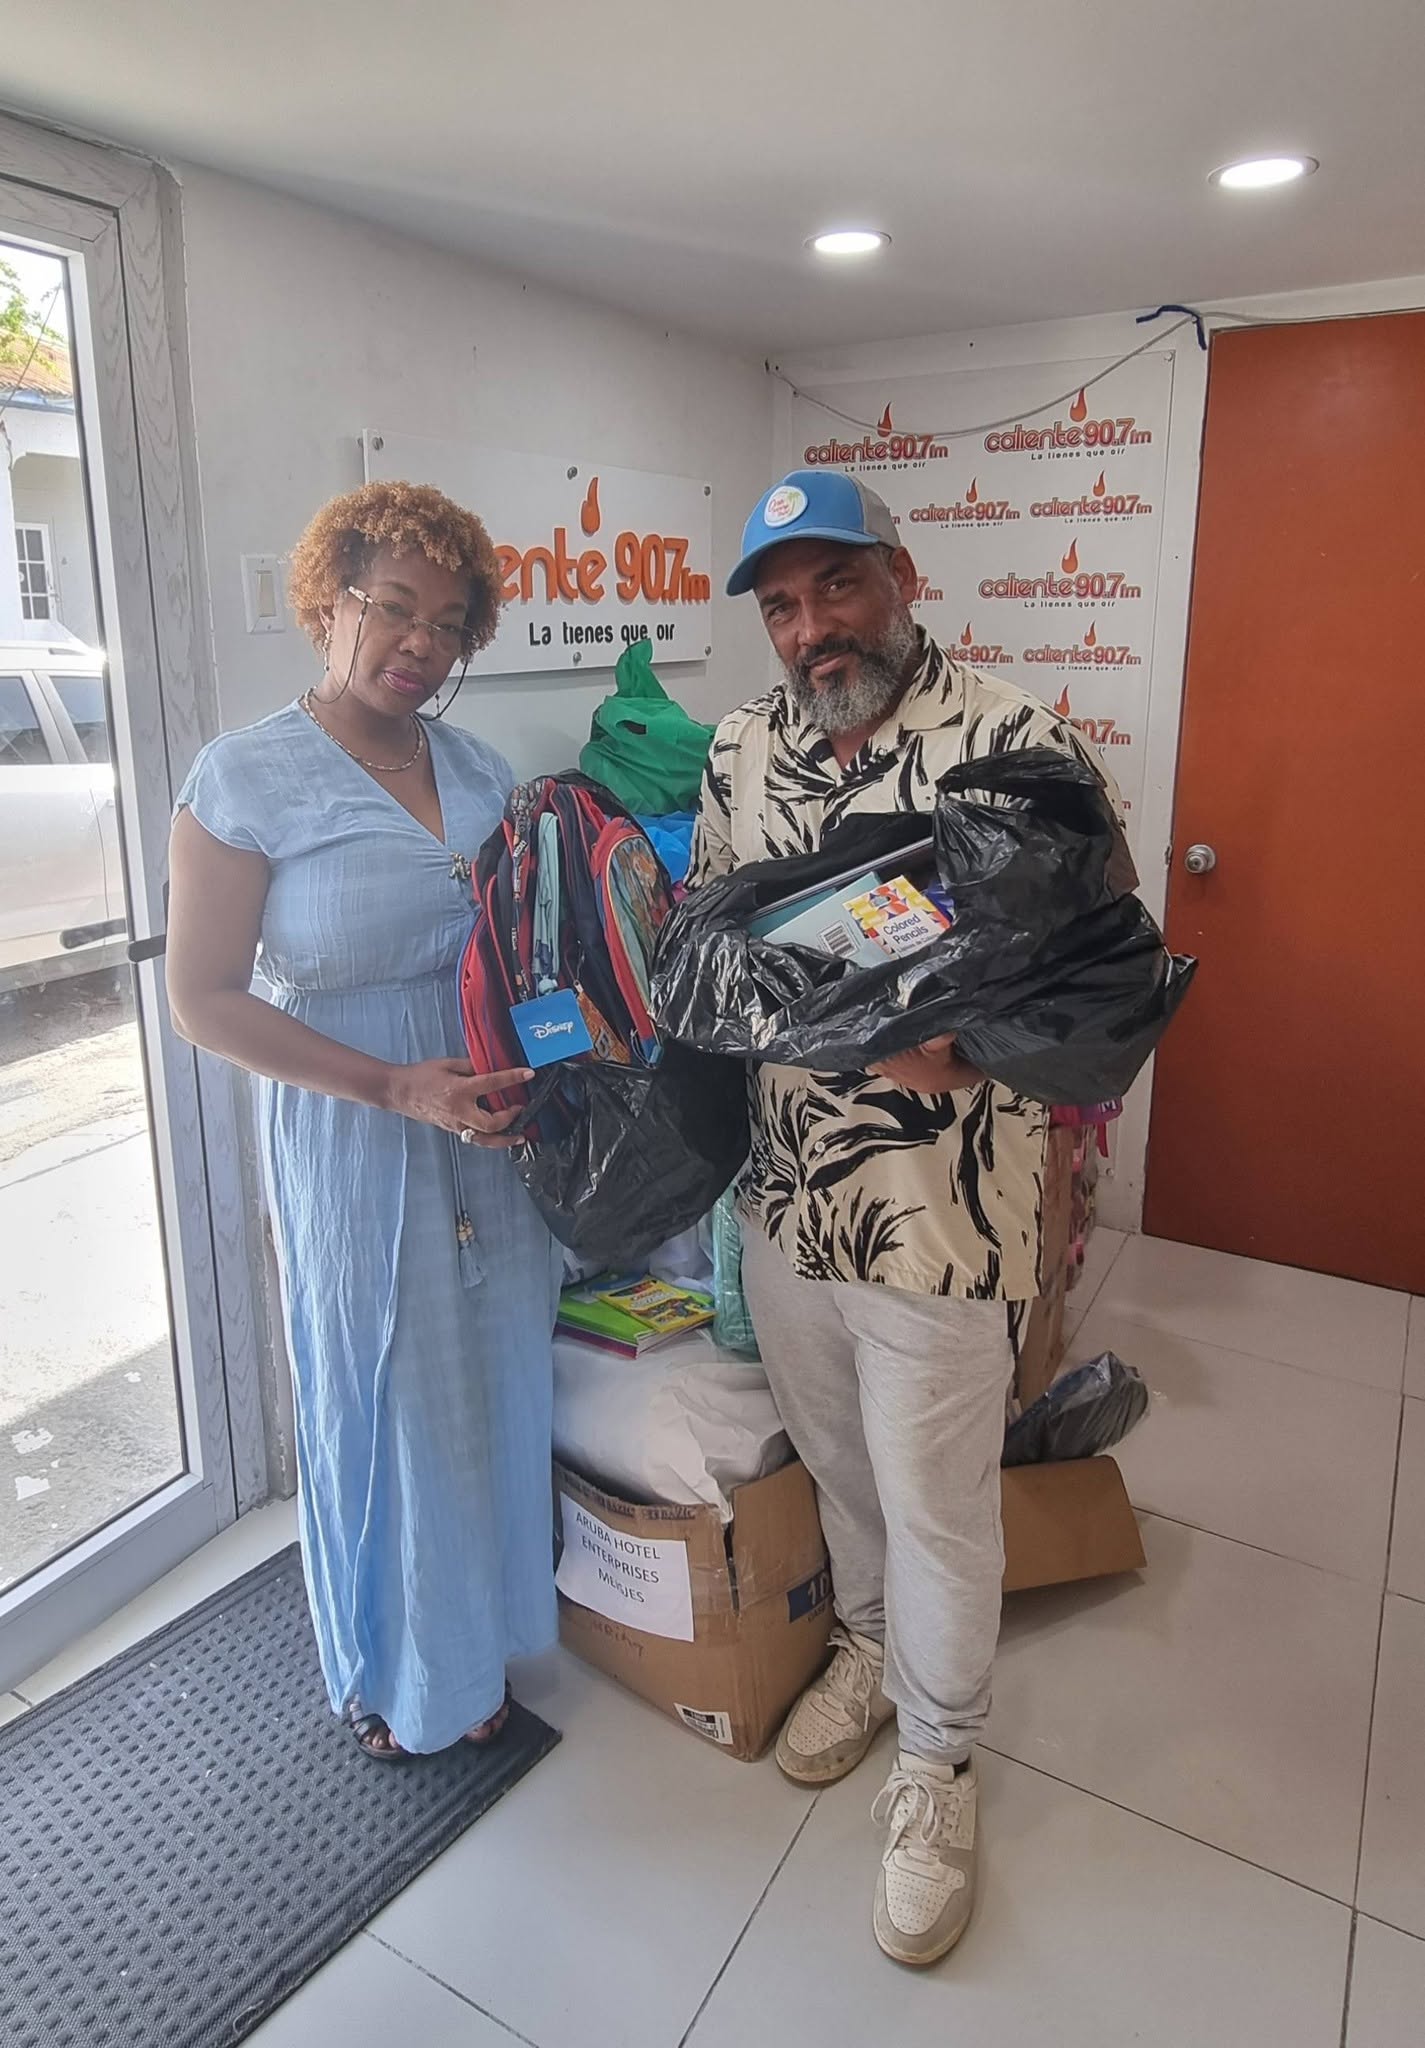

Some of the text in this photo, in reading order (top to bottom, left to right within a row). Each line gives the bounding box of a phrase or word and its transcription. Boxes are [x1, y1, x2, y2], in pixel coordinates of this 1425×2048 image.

[804, 436, 889, 465] caliente
[984, 421, 1085, 453] caliente
[978, 572, 1074, 599] caliente
[529, 622, 674, 646] La tienes que oir
[883, 913, 922, 935] Colored
[893, 926, 929, 944] Pencils
[529, 1021, 574, 1039] Disney
[576, 1511, 612, 1545] ARUBA
[614, 1538, 661, 1560] HOTEL
[582, 1535, 660, 1584] ENTERPRISES
